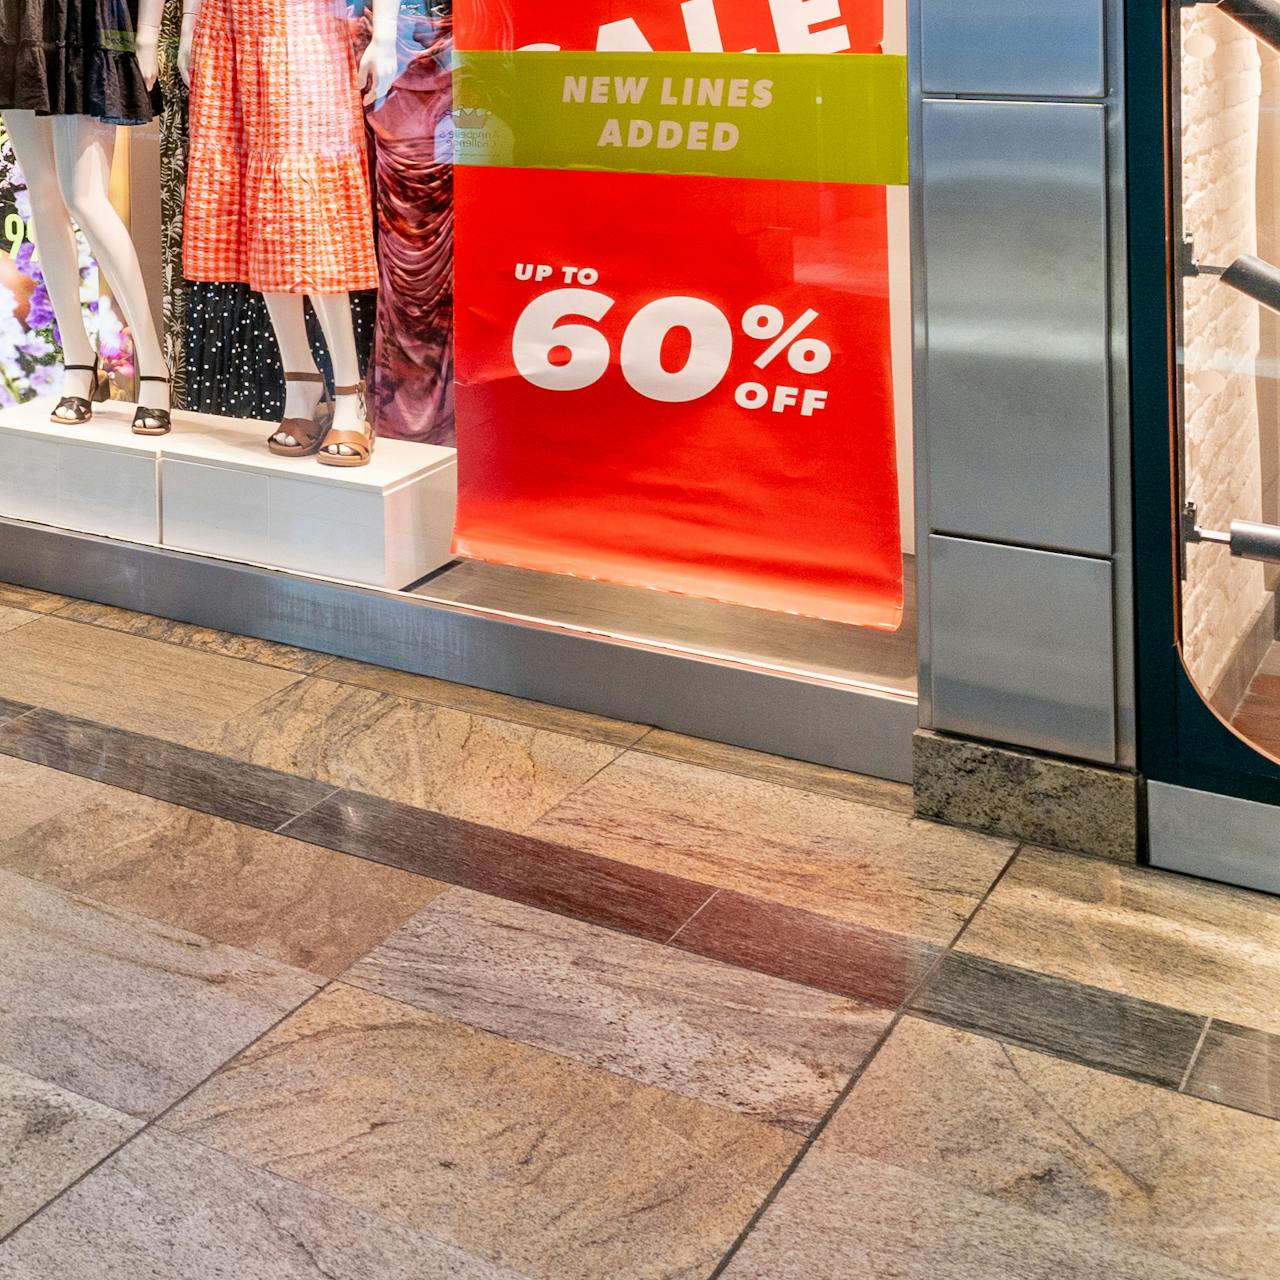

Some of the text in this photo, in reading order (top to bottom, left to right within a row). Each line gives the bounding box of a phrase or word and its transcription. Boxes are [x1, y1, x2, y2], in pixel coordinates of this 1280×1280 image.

[561, 75, 774, 109] NEW LINES
[596, 118, 740, 152] ADDED
[514, 263, 599, 286] UP TO
[512, 288, 832, 403] 60%
[734, 381, 829, 417] OFF
